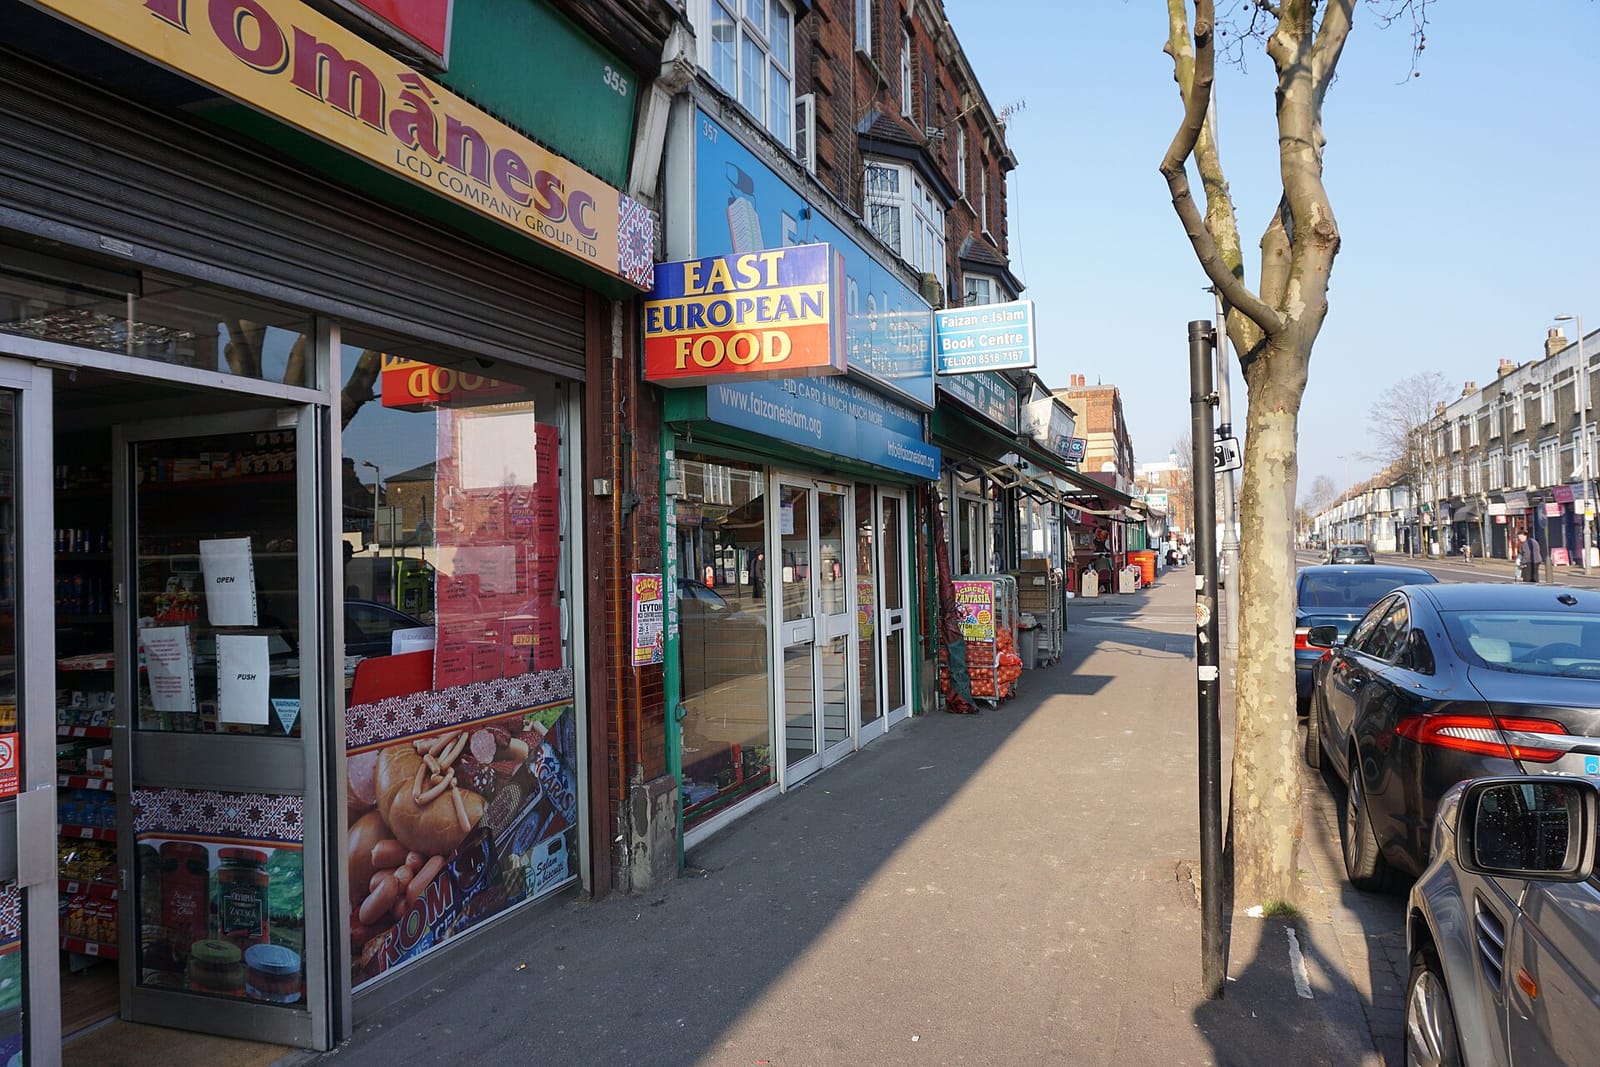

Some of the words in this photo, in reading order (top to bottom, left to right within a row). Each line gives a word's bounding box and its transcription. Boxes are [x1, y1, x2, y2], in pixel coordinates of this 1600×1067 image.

[603, 65, 628, 97] 355
[703, 119, 719, 145] 357
[396, 148, 432, 177] LCD
[437, 170, 521, 222] COMPANY
[525, 214, 573, 245] GROUP
[576, 243, 598, 258] LTD
[684, 251, 785, 297] EAST
[646, 290, 824, 334] EUROPEAN
[941, 315, 978, 329] Faizan
[981, 313, 989, 324] e
[992, 309, 1024, 322] Islam
[675, 330, 793, 370] FOOD
[942, 335, 975, 351] Book
[979, 332, 1024, 348] Centre
[942, 355, 977, 368] TEL:020
[979, 353, 1000, 364] 8518
[799, 384, 820, 402] CARD
[822, 392, 827, 405] &
[828, 394, 848, 414] MUCH
[955, 593, 991, 604] FANTASIA
[960, 586, 985, 595] CIRCUS
[378, 871, 454, 974] ROM
